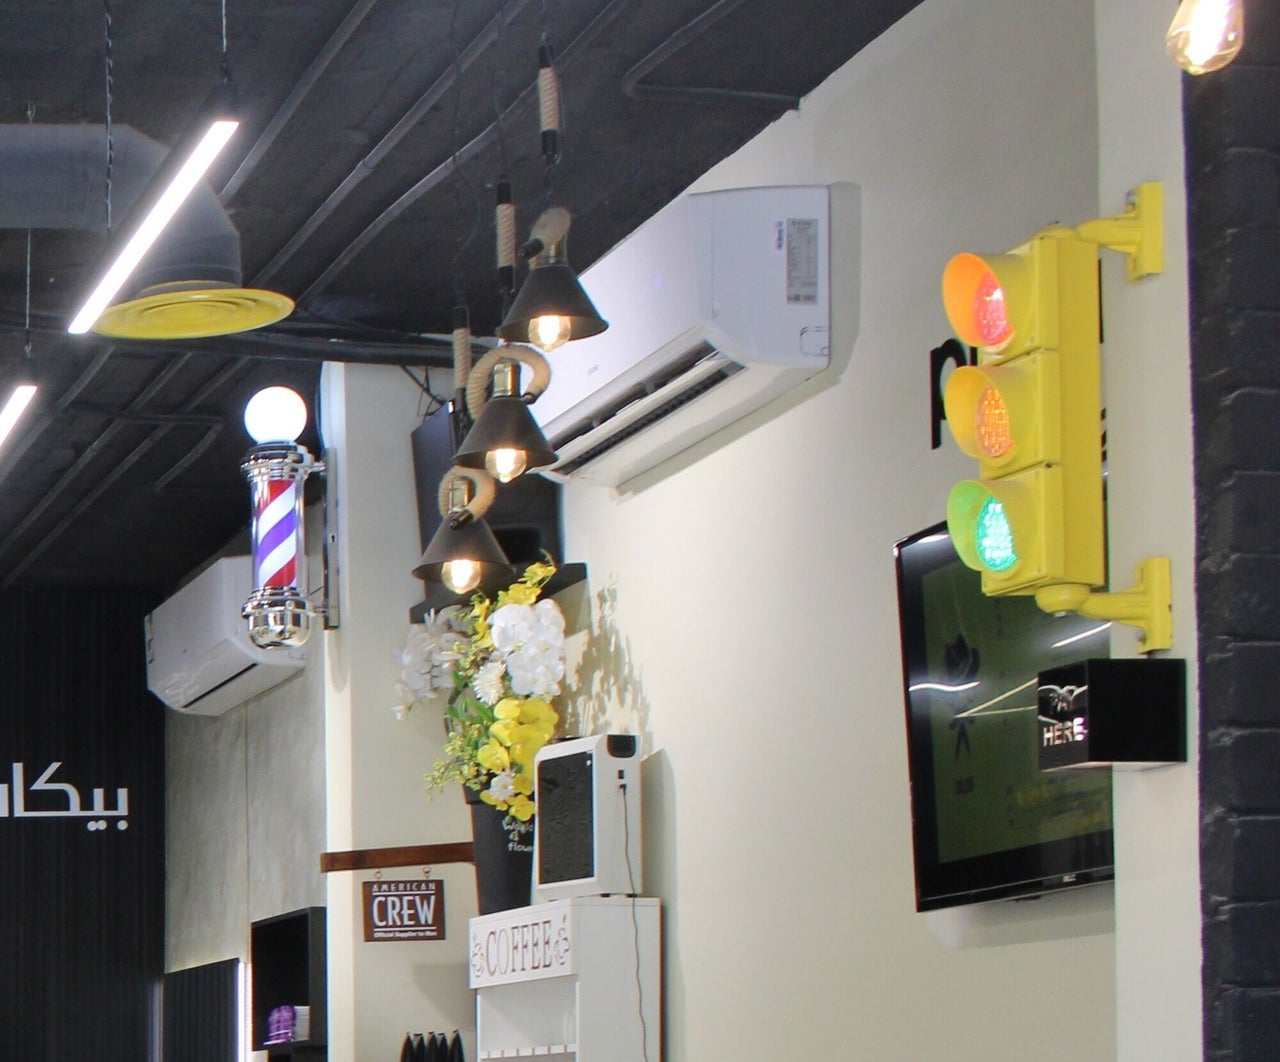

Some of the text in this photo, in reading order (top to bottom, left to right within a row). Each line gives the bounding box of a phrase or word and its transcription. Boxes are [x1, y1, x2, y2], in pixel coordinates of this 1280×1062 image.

[372, 882, 436, 892] AMERICAN
[372, 895, 436, 927] CREW
[486, 920, 552, 977] COFFEE
